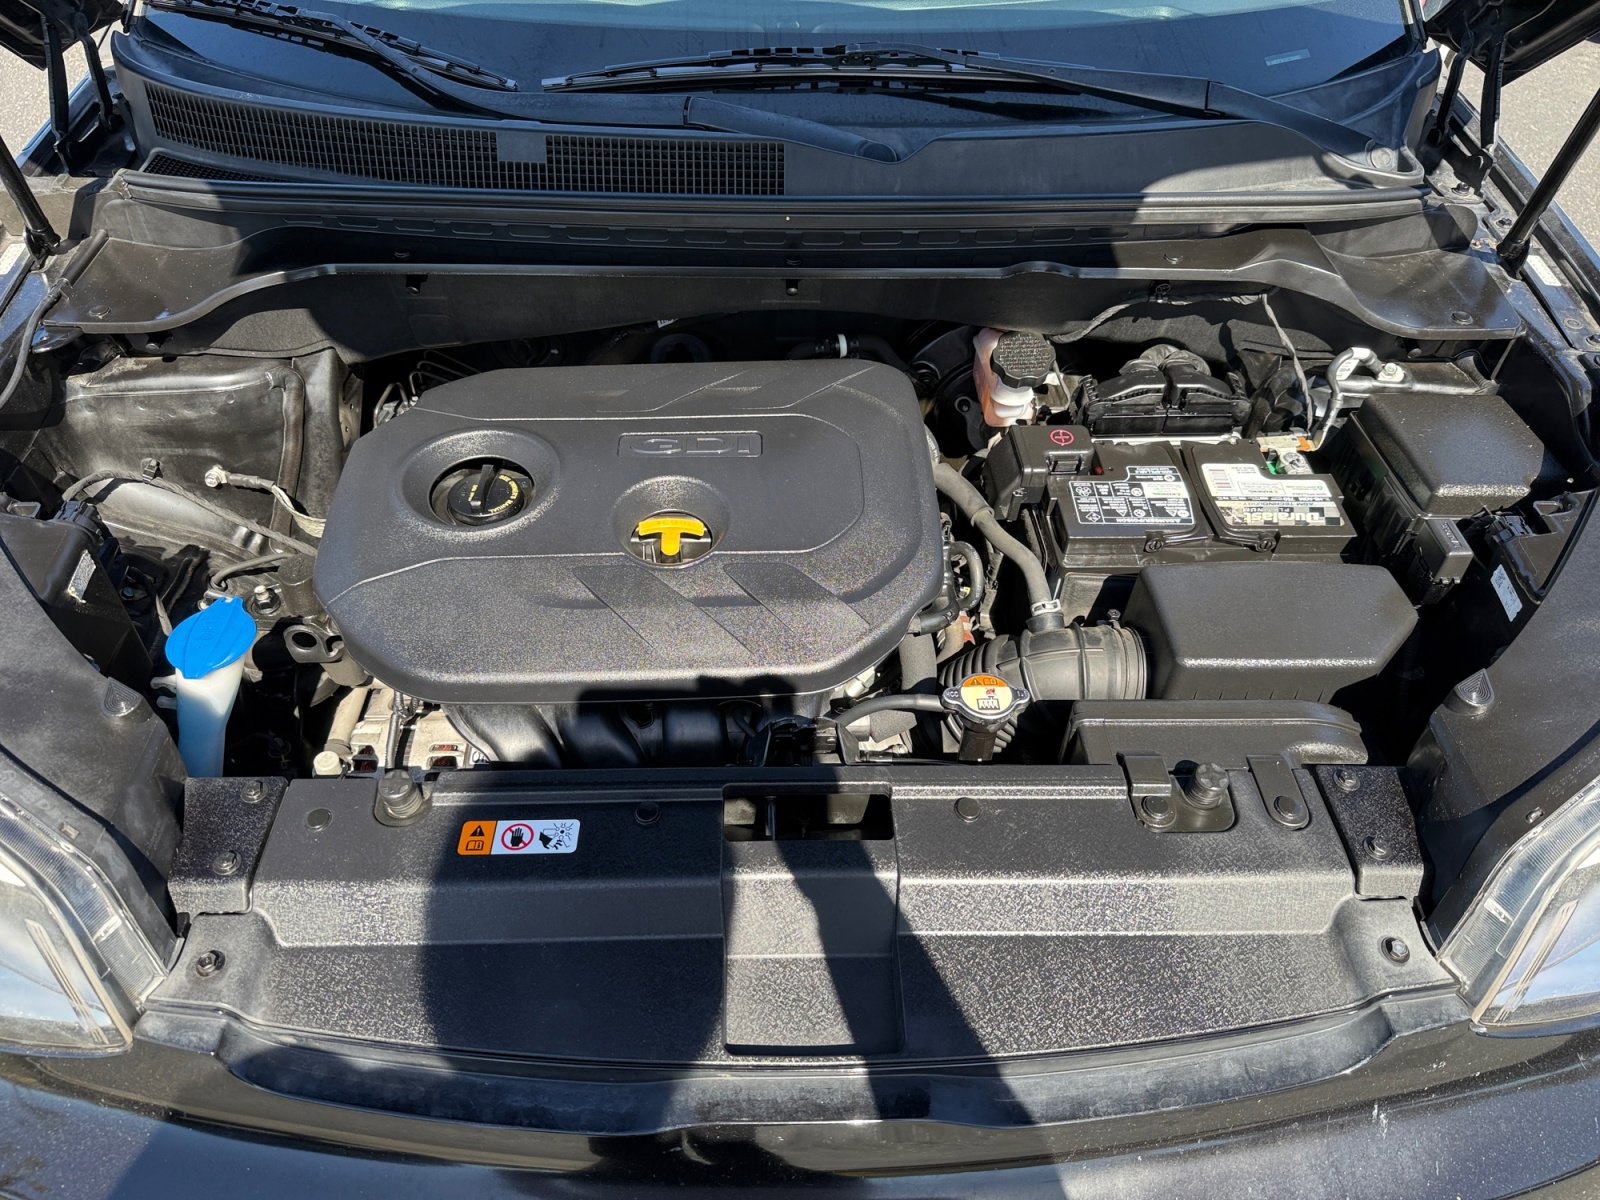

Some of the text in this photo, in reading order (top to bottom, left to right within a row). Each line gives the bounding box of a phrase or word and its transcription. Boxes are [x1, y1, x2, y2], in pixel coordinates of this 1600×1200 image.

[630, 437, 750, 454] GDI
[488, 499, 514, 514] MANUAL
[1243, 512, 1320, 524] Duralast
